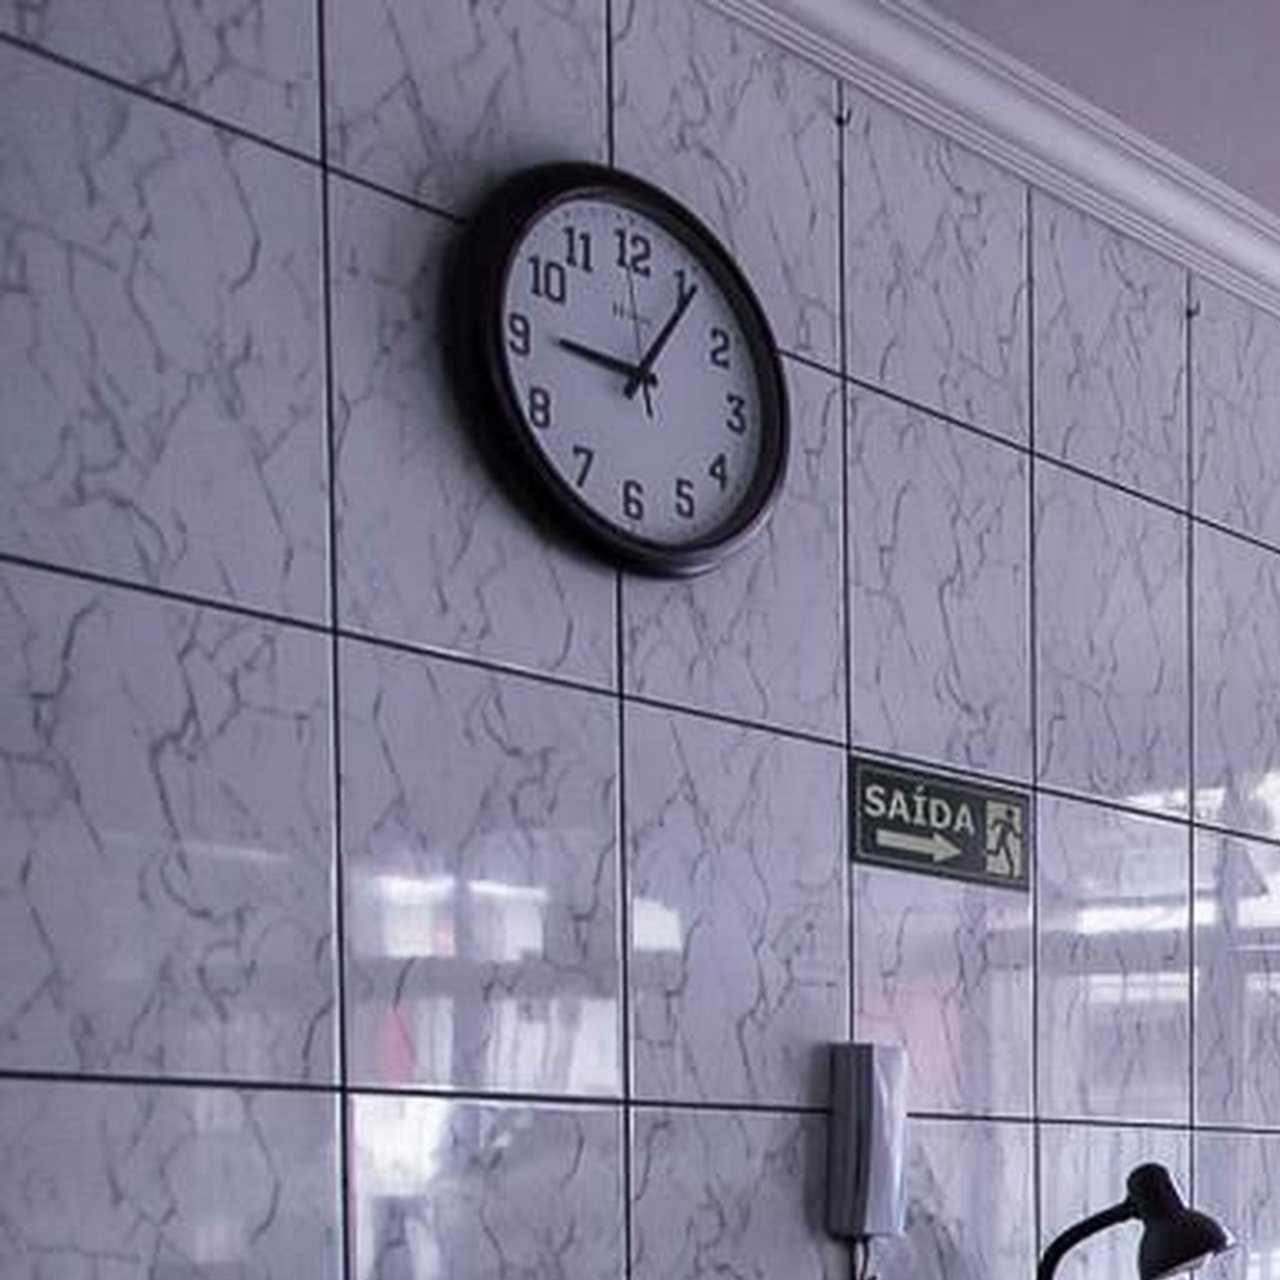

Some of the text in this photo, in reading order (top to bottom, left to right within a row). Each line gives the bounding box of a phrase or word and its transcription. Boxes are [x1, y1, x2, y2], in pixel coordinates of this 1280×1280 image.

[564, 227, 593, 273] 11
[615, 228, 651, 277] 12
[528, 256, 566, 303] 10
[673, 269, 692, 302] 1
[509, 312, 530, 357] 9
[710, 327, 730, 369] 2
[529, 387, 550, 429] 8
[726, 394, 746, 435] 3
[572, 445, 594, 488] 7
[709, 453, 727, 490] 4
[622, 480, 644, 521] 6
[675, 478, 694, 519] 5
[864, 784, 975, 835] SAÍDA
